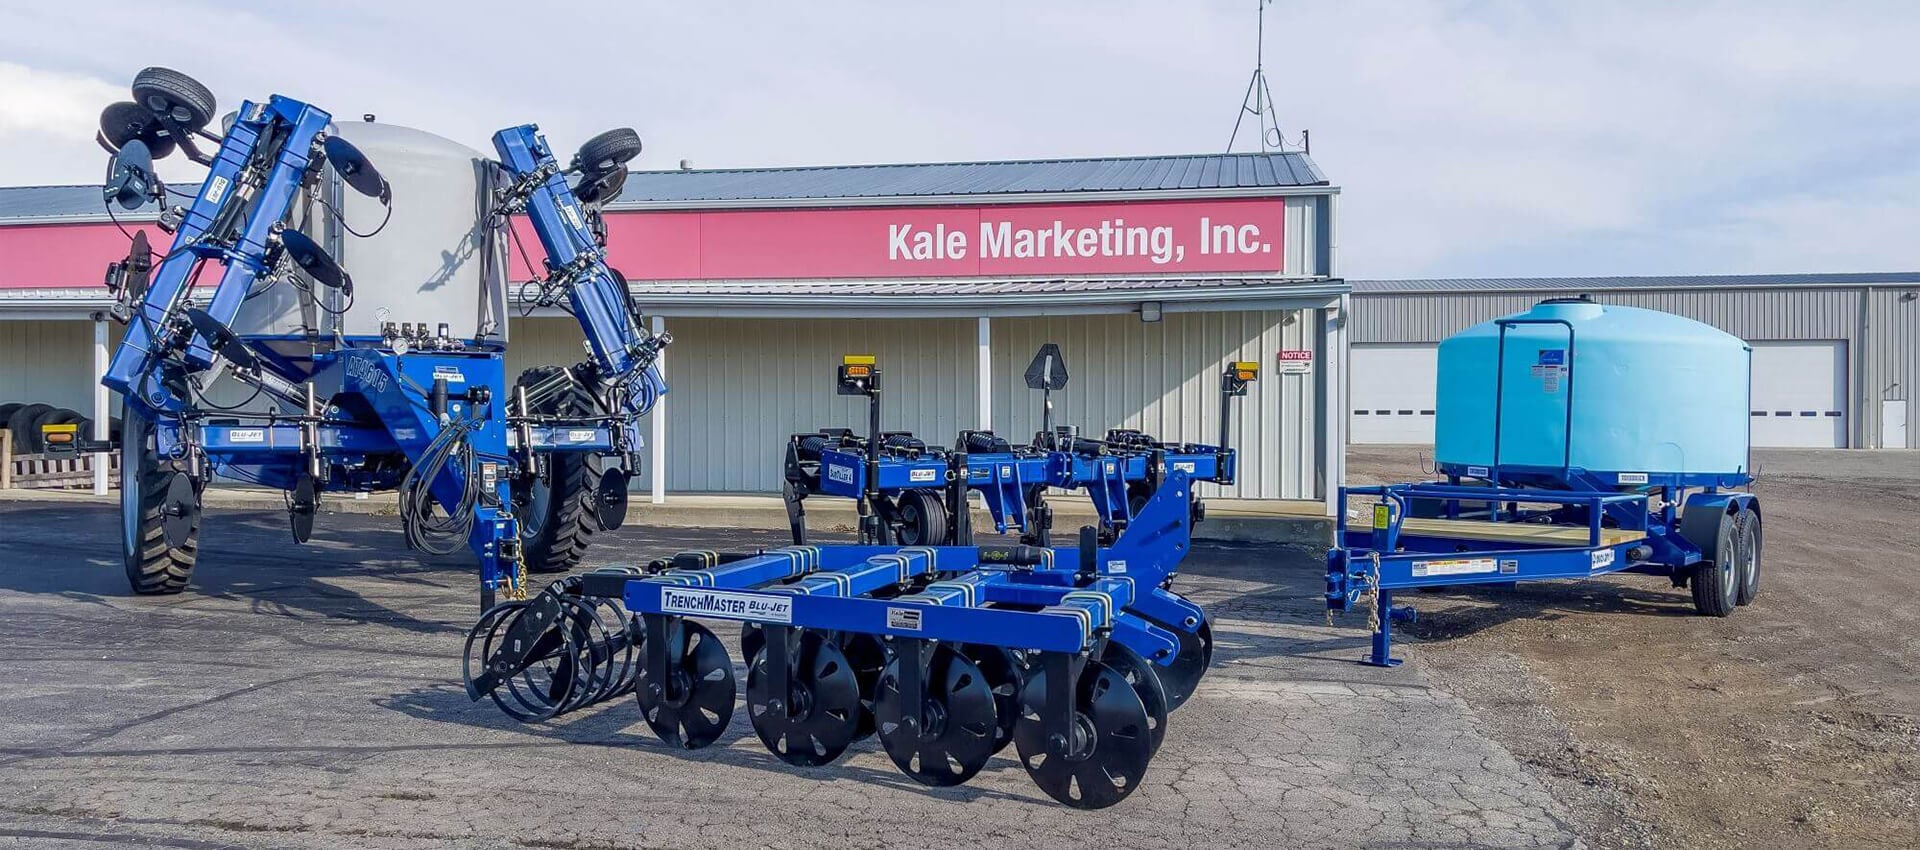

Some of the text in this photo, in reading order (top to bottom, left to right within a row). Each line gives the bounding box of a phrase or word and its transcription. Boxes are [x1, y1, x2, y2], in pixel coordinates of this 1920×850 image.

[888, 216, 1272, 264] Kale Marketing, Inc.
[1281, 351, 1310, 359] NOTICE
[346, 355, 389, 393] AT4615
[748, 600, 789, 613] BLU-JET
